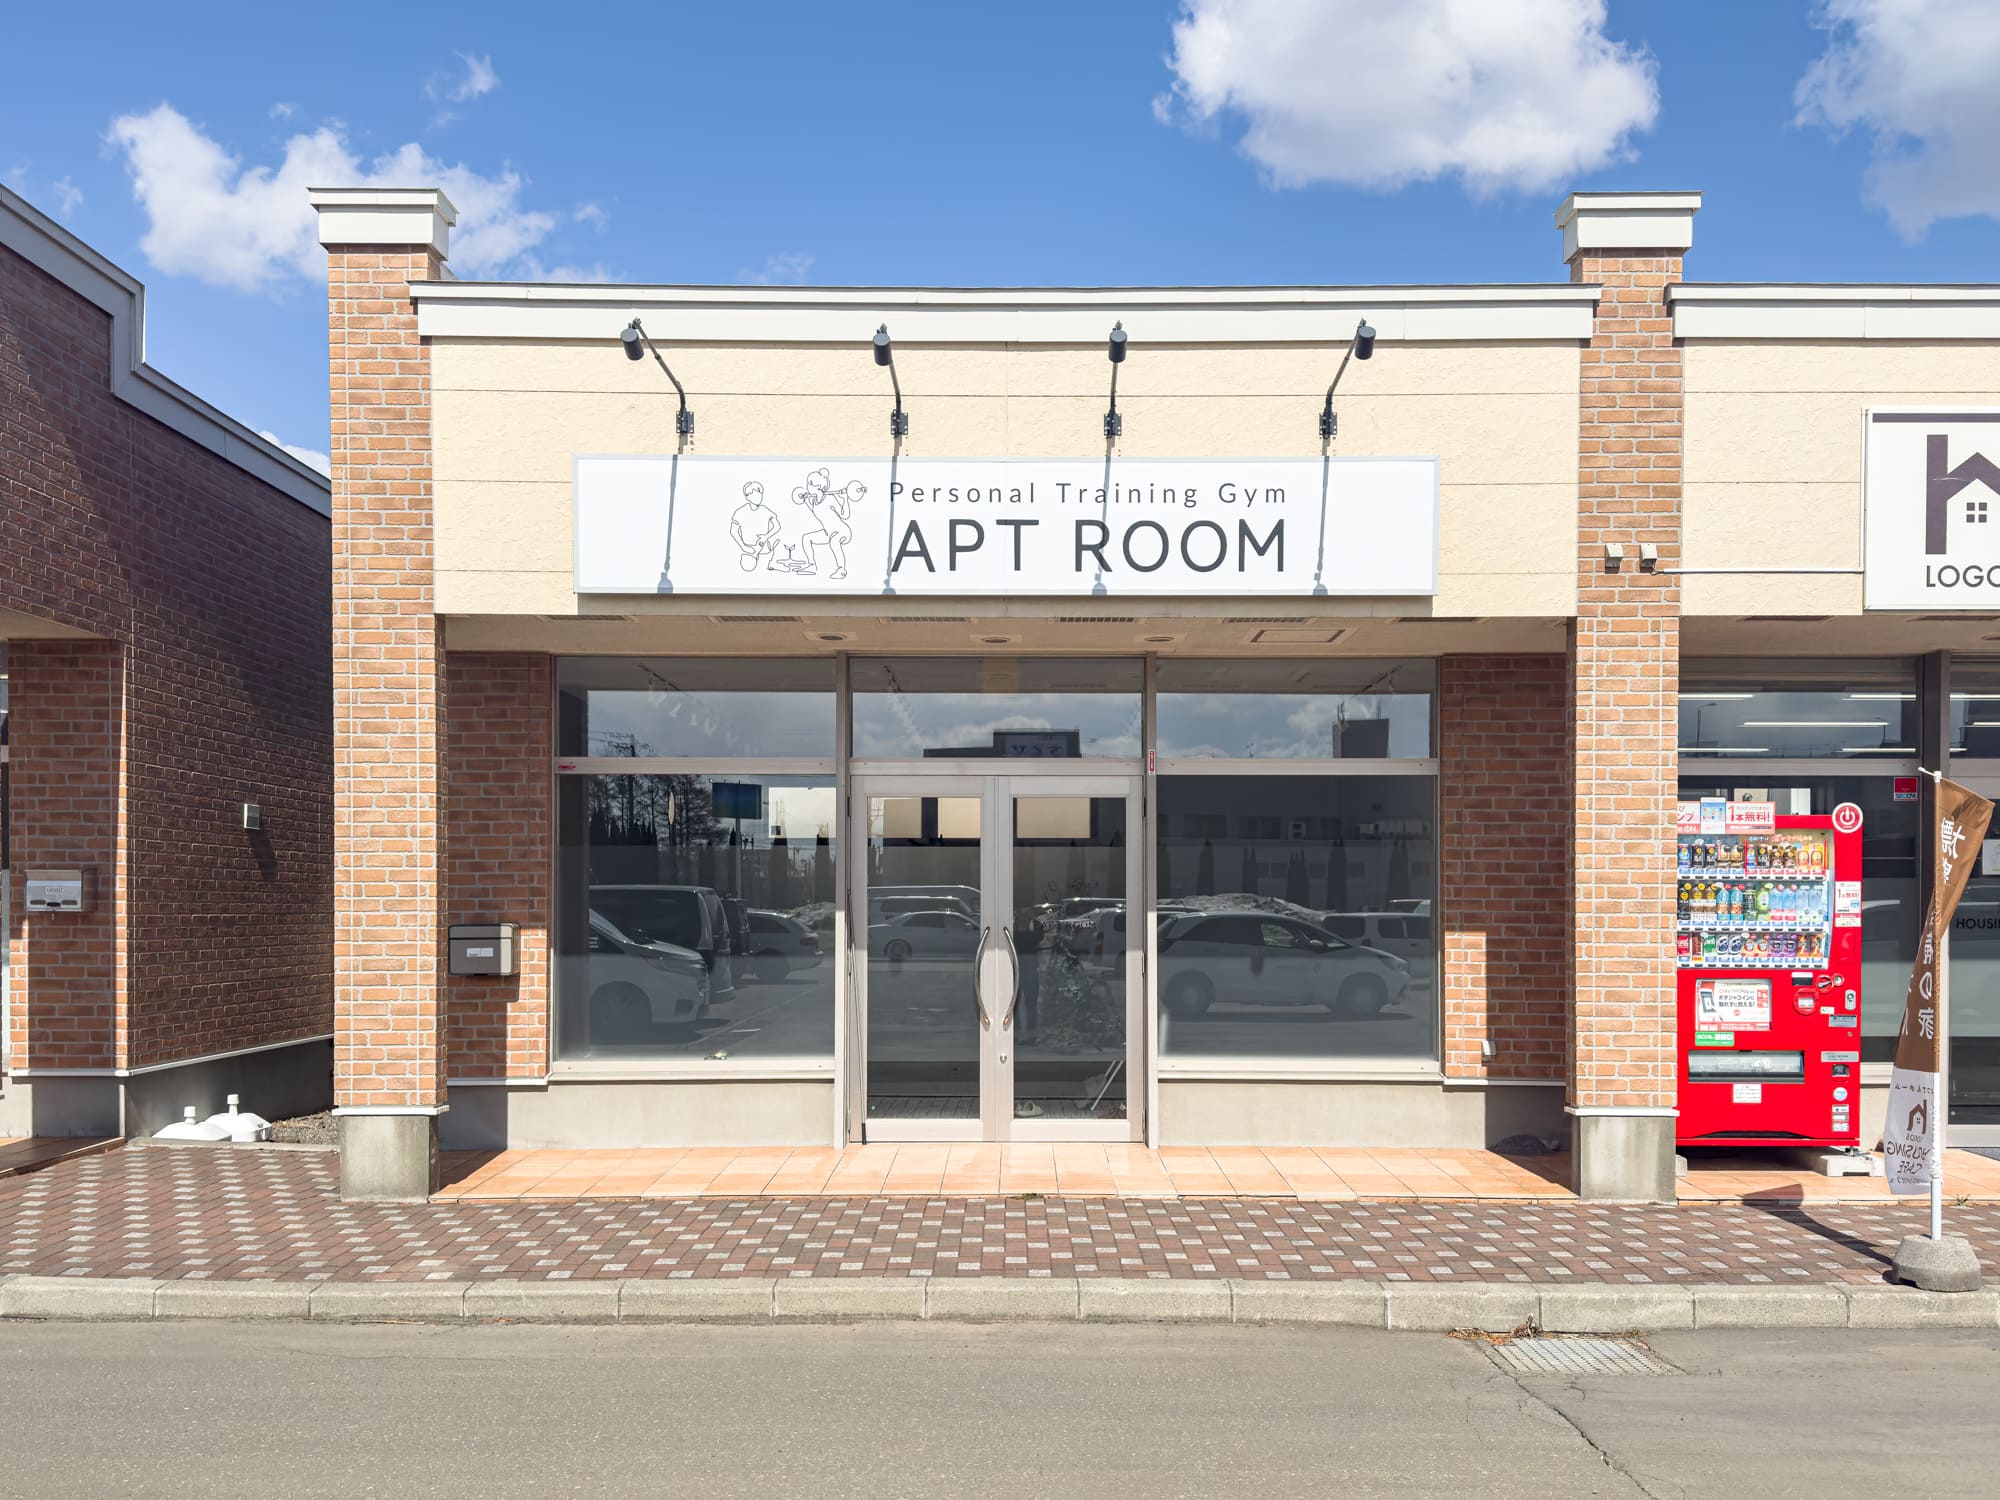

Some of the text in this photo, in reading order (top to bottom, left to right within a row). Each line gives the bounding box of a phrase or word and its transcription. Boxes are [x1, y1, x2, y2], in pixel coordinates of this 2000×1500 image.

[890, 482, 1286, 508] Personal Training Gym
[891, 518, 1285, 573] APT ROOM
[1956, 918, 2000, 929] HOUSI
